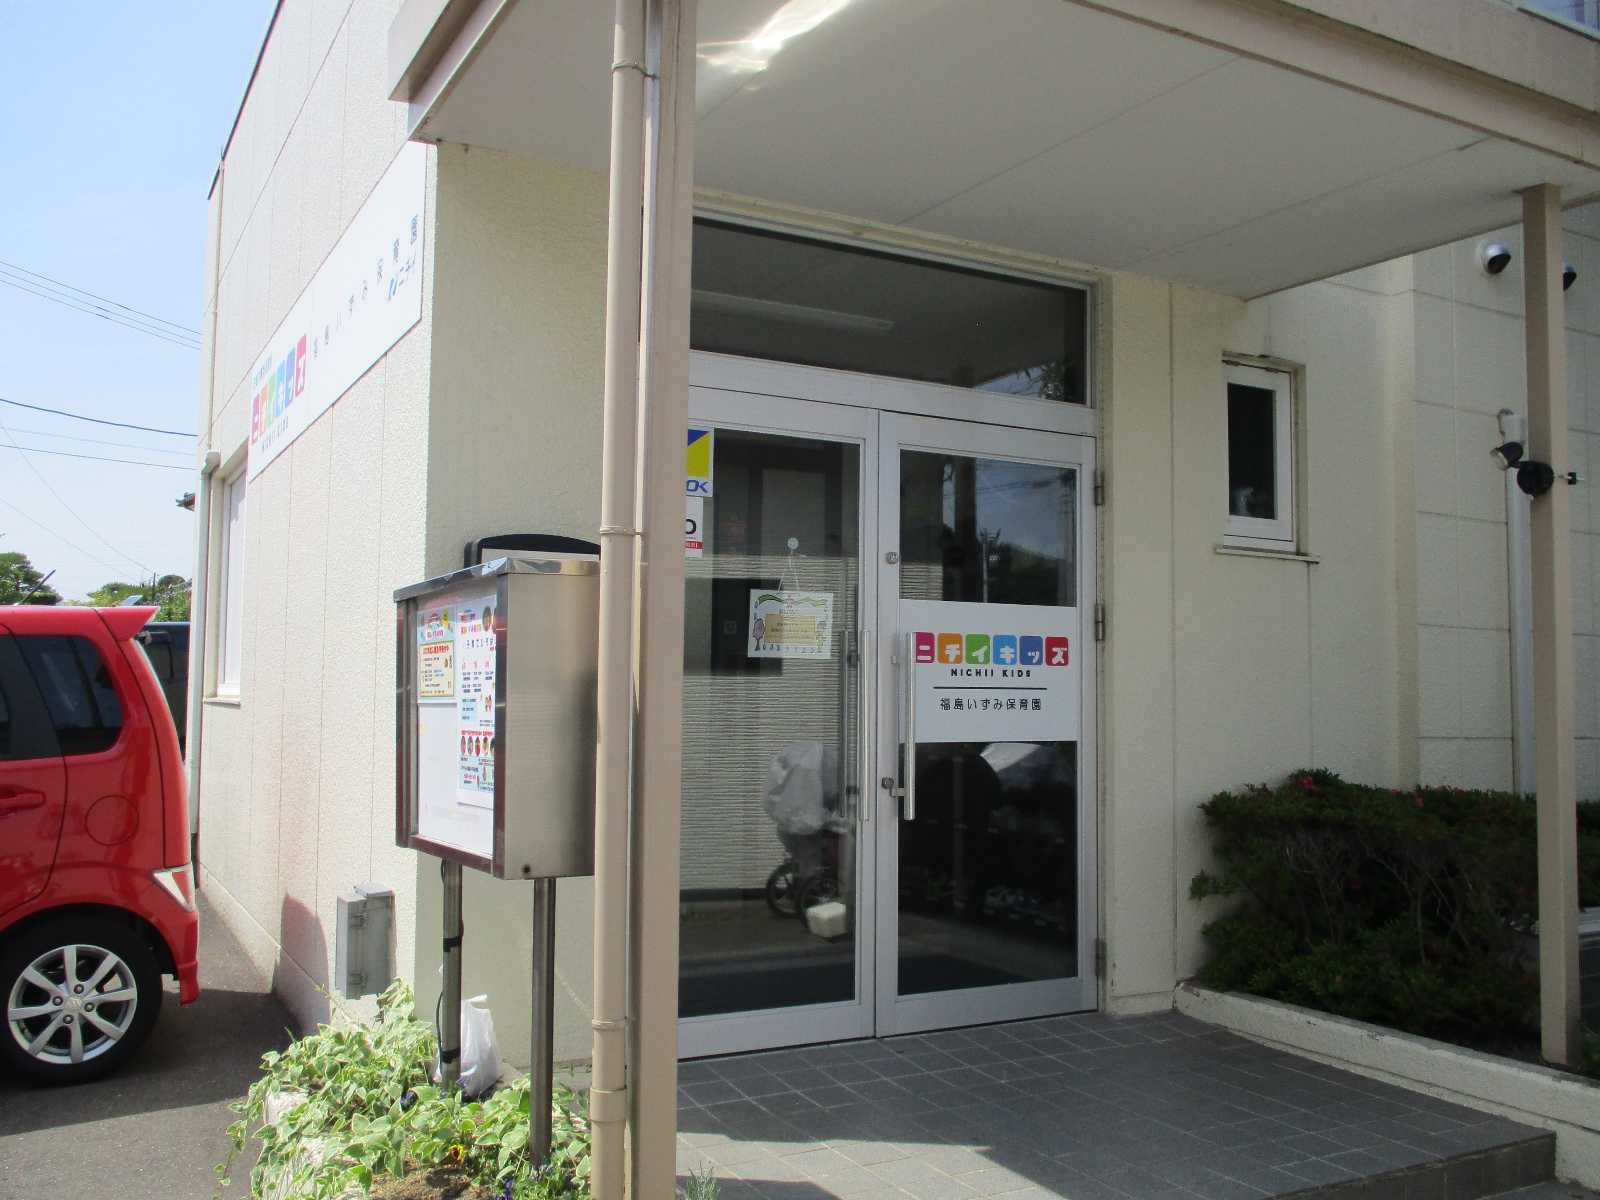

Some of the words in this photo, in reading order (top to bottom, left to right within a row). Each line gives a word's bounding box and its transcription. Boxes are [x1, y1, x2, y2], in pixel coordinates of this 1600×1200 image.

[916, 634, 1069, 666] ニチイキッズ
[950, 668, 994, 678] NICHII
[1002, 668, 1032, 678] KIDS
[940, 698, 1042, 711] 福島いずみ保育園
